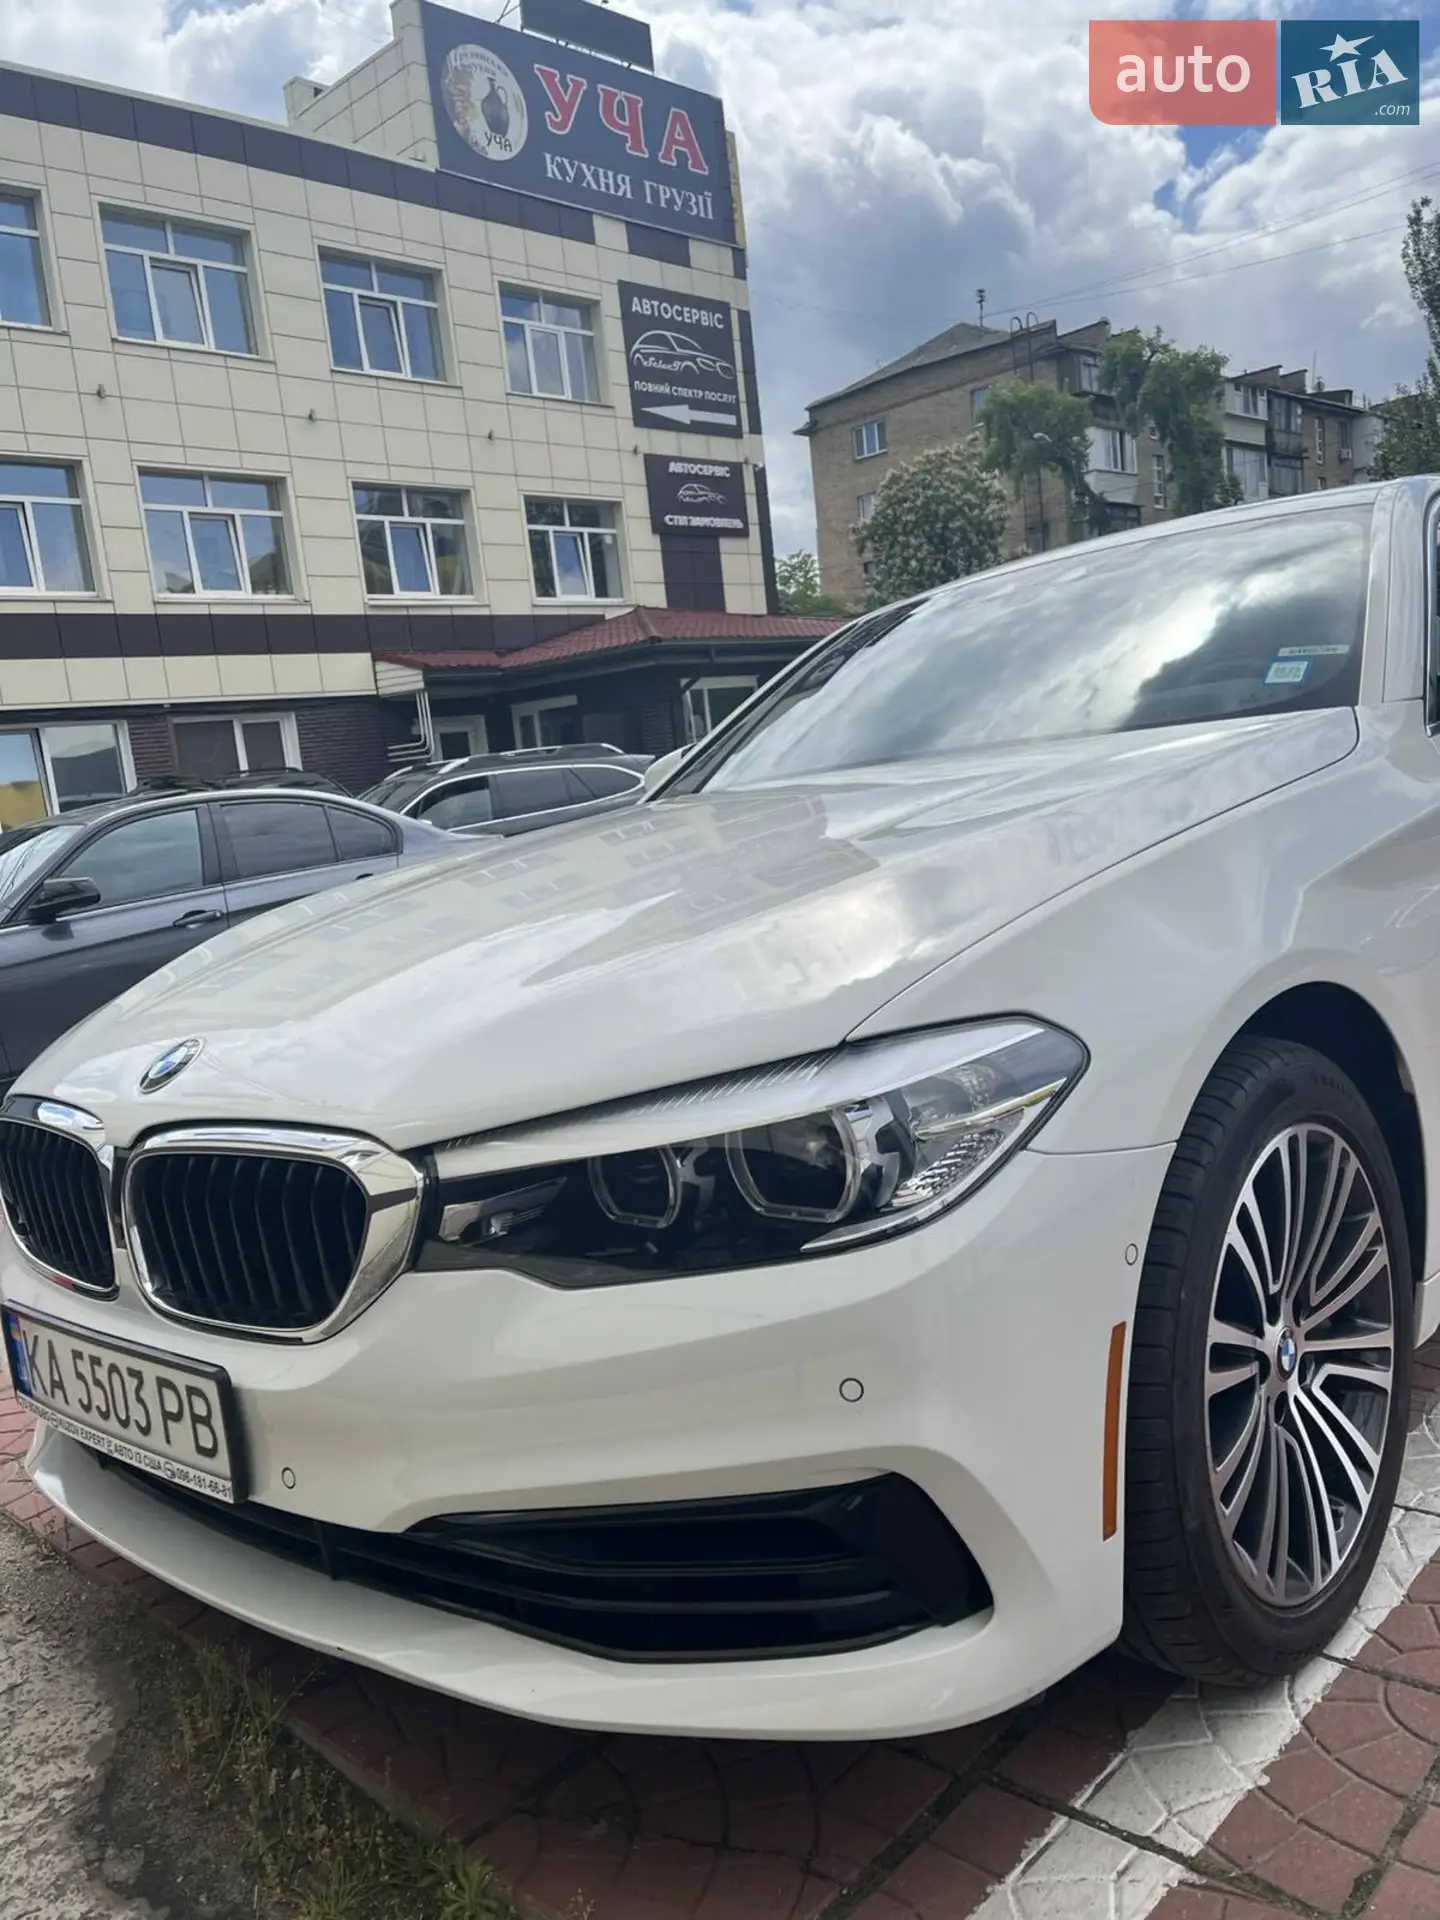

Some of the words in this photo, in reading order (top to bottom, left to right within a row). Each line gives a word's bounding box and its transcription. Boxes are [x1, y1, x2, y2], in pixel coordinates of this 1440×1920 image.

[533, 63, 709, 175] УЧА
[484, 131, 513, 153] УЧА
[544, 152, 633, 200] КУХНЯ
[643, 179, 715, 220] ГРУЗІЇ
[631, 296, 725, 330] АВТОСЕРВІС
[634, 381, 670, 394] ПОВНИЙ
[671, 386, 704, 399] СПЕКТР
[704, 391, 737, 403] ПОСЛУГ
[668, 461, 731, 478] АВТОСЕРВІС
[22, 1329, 70, 1406] KA
[71, 1349, 152, 1437] 5503
[155, 1376, 218, 1459] PB
[80, 1427, 106, 1449] EXPERT
